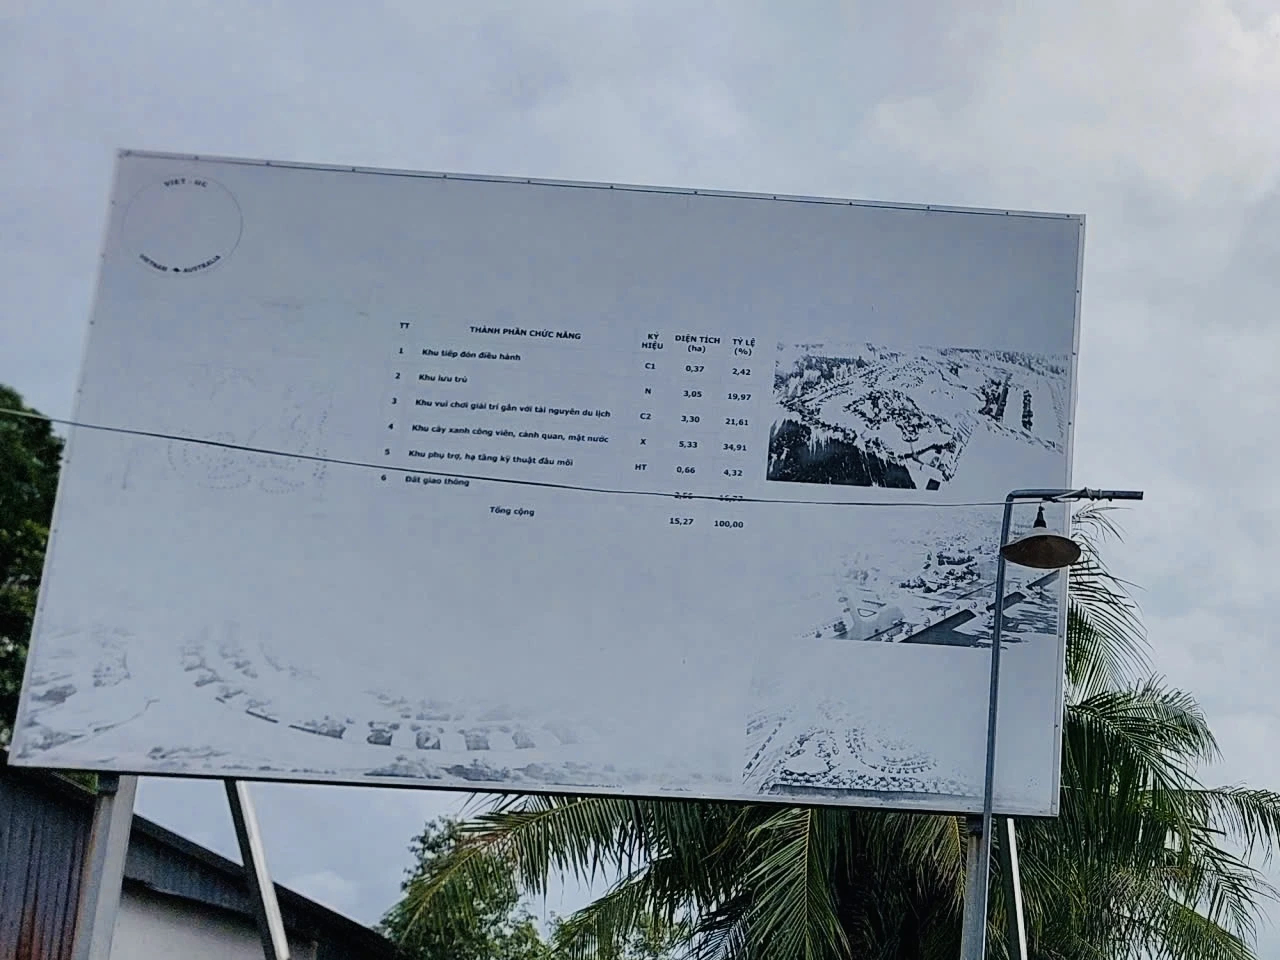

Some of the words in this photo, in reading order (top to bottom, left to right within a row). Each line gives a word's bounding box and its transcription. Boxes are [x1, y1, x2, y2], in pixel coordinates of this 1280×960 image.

[400, 321, 410, 329] TT
[675, 333, 697, 343] DIỆN
[699, 334, 720, 344] TÍCH
[642, 340, 663, 350] HIỆU
[688, 344, 706, 353] (ha)
[422, 348, 439, 356] Khu
[734, 347, 752, 356] (%)
[686, 364, 704, 373] 0,37
[732, 367, 750, 376] 2,42
[395, 371, 400, 379] 2
[419, 373, 436, 381] Khu
[683, 389, 702, 398] 3,05
[728, 392, 751, 401] 19,97
[392, 396, 397, 404] 3
[415, 398, 432, 406] Khu
[435, 399, 448, 407] vui
[489, 402, 499, 410] trí
[549, 407, 580, 416] nguyên
[582, 408, 593, 416] du
[595, 409, 610, 418] lịch
[640, 412, 651, 420] C2
[681, 414, 700, 423] 3,30
[388, 422, 393, 430] 4
[725, 417, 748, 426] 21,61
[412, 423, 429, 432] Khu
[431, 424, 446, 434] cây
[448, 426, 470, 434] xanh
[472, 427, 493, 437] công
[542, 433, 565, 441] quan,
[640, 437, 646, 445] X
[679, 440, 697, 448] 5,33
[723, 443, 747, 451] 34,91
[409, 449, 426, 457] Khu
[428, 451, 445, 459] phụ
[464, 452, 476, 461] hạ
[513, 455, 536, 464] thuật
[677, 465, 695, 475] 0,66
[723, 468, 742, 477] 4,32
[381, 473, 387, 481] 6
[423, 476, 442, 485] giao
[444, 477, 470, 487] thông
[670, 517, 694, 526] 15,27
[714, 519, 743, 528] 100,00
